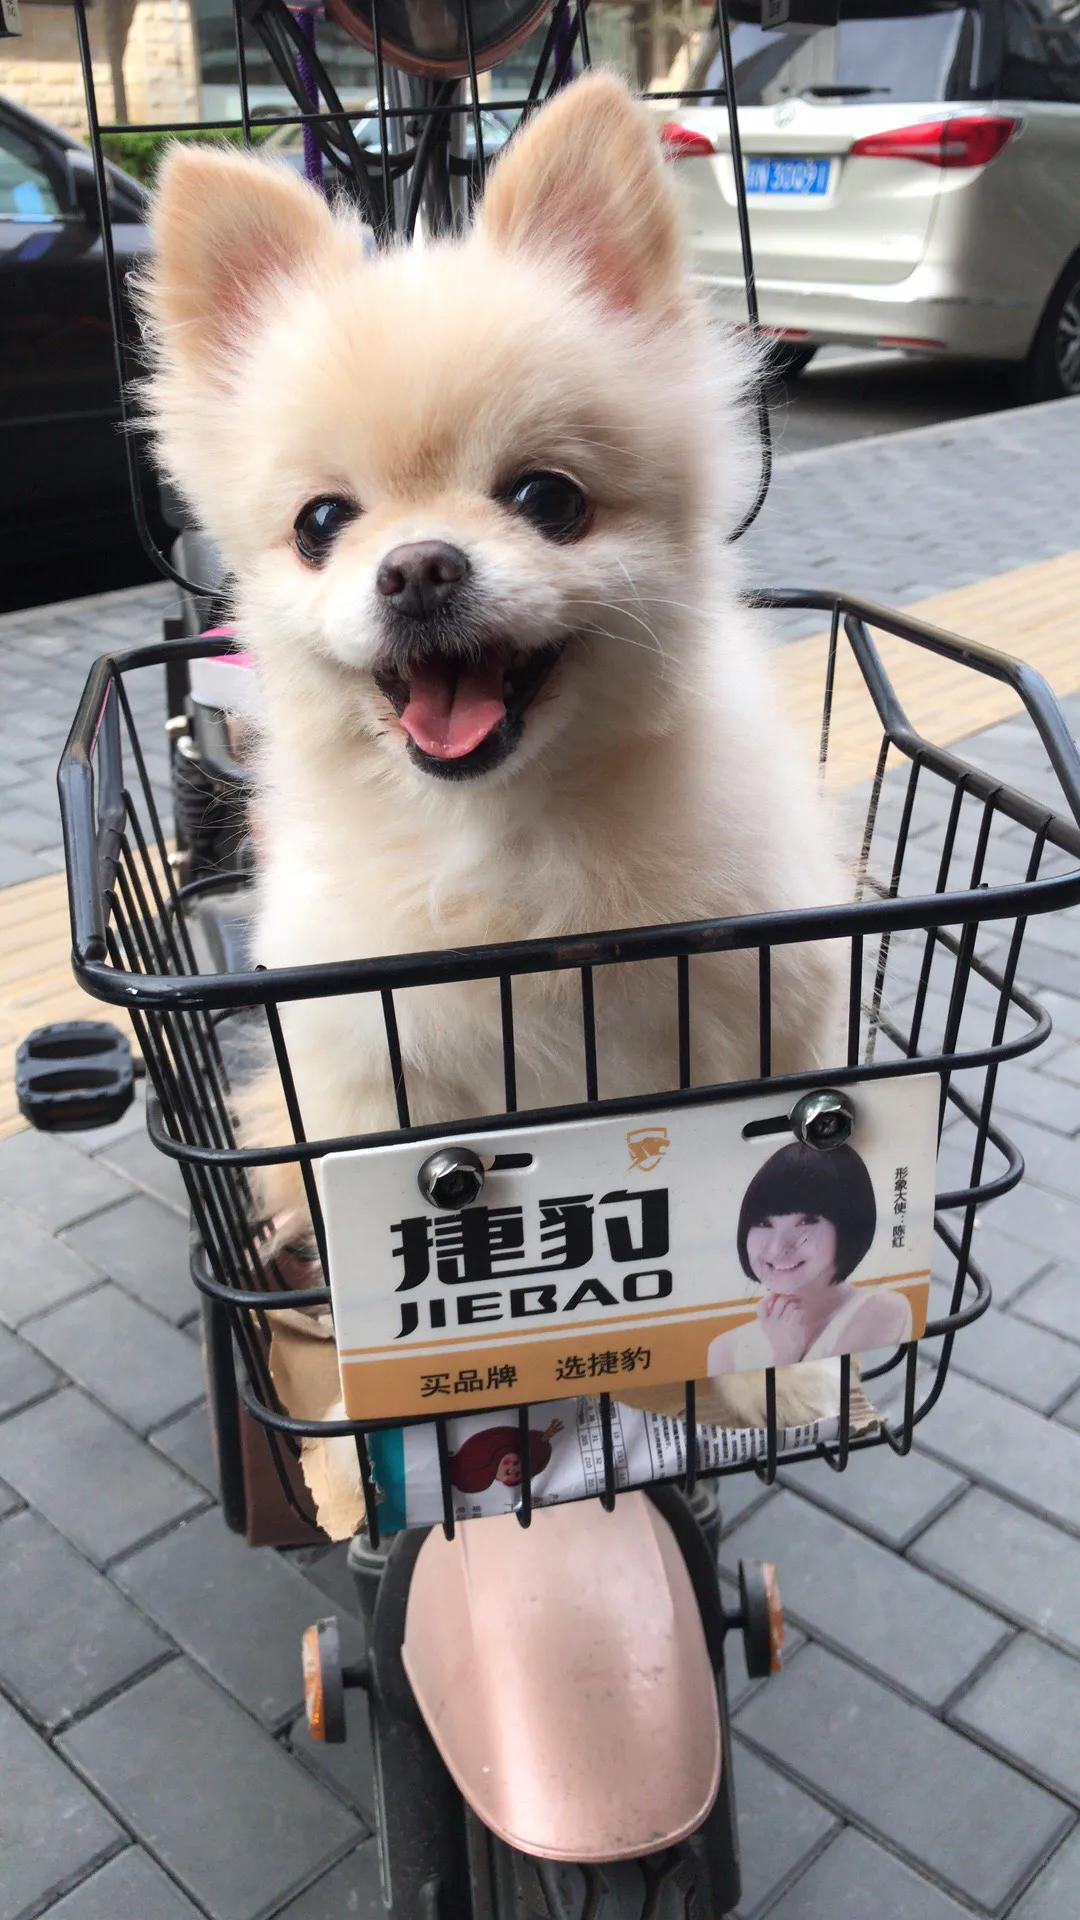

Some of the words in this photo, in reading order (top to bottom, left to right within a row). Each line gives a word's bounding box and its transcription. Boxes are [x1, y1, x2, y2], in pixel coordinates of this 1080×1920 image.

[390, 1187, 670, 1292] 捷豹
[393, 1269, 673, 1339] JIEBAO
[420, 1364, 518, 1398] 买品牌
[555, 1346, 651, 1381] 选捷豹
